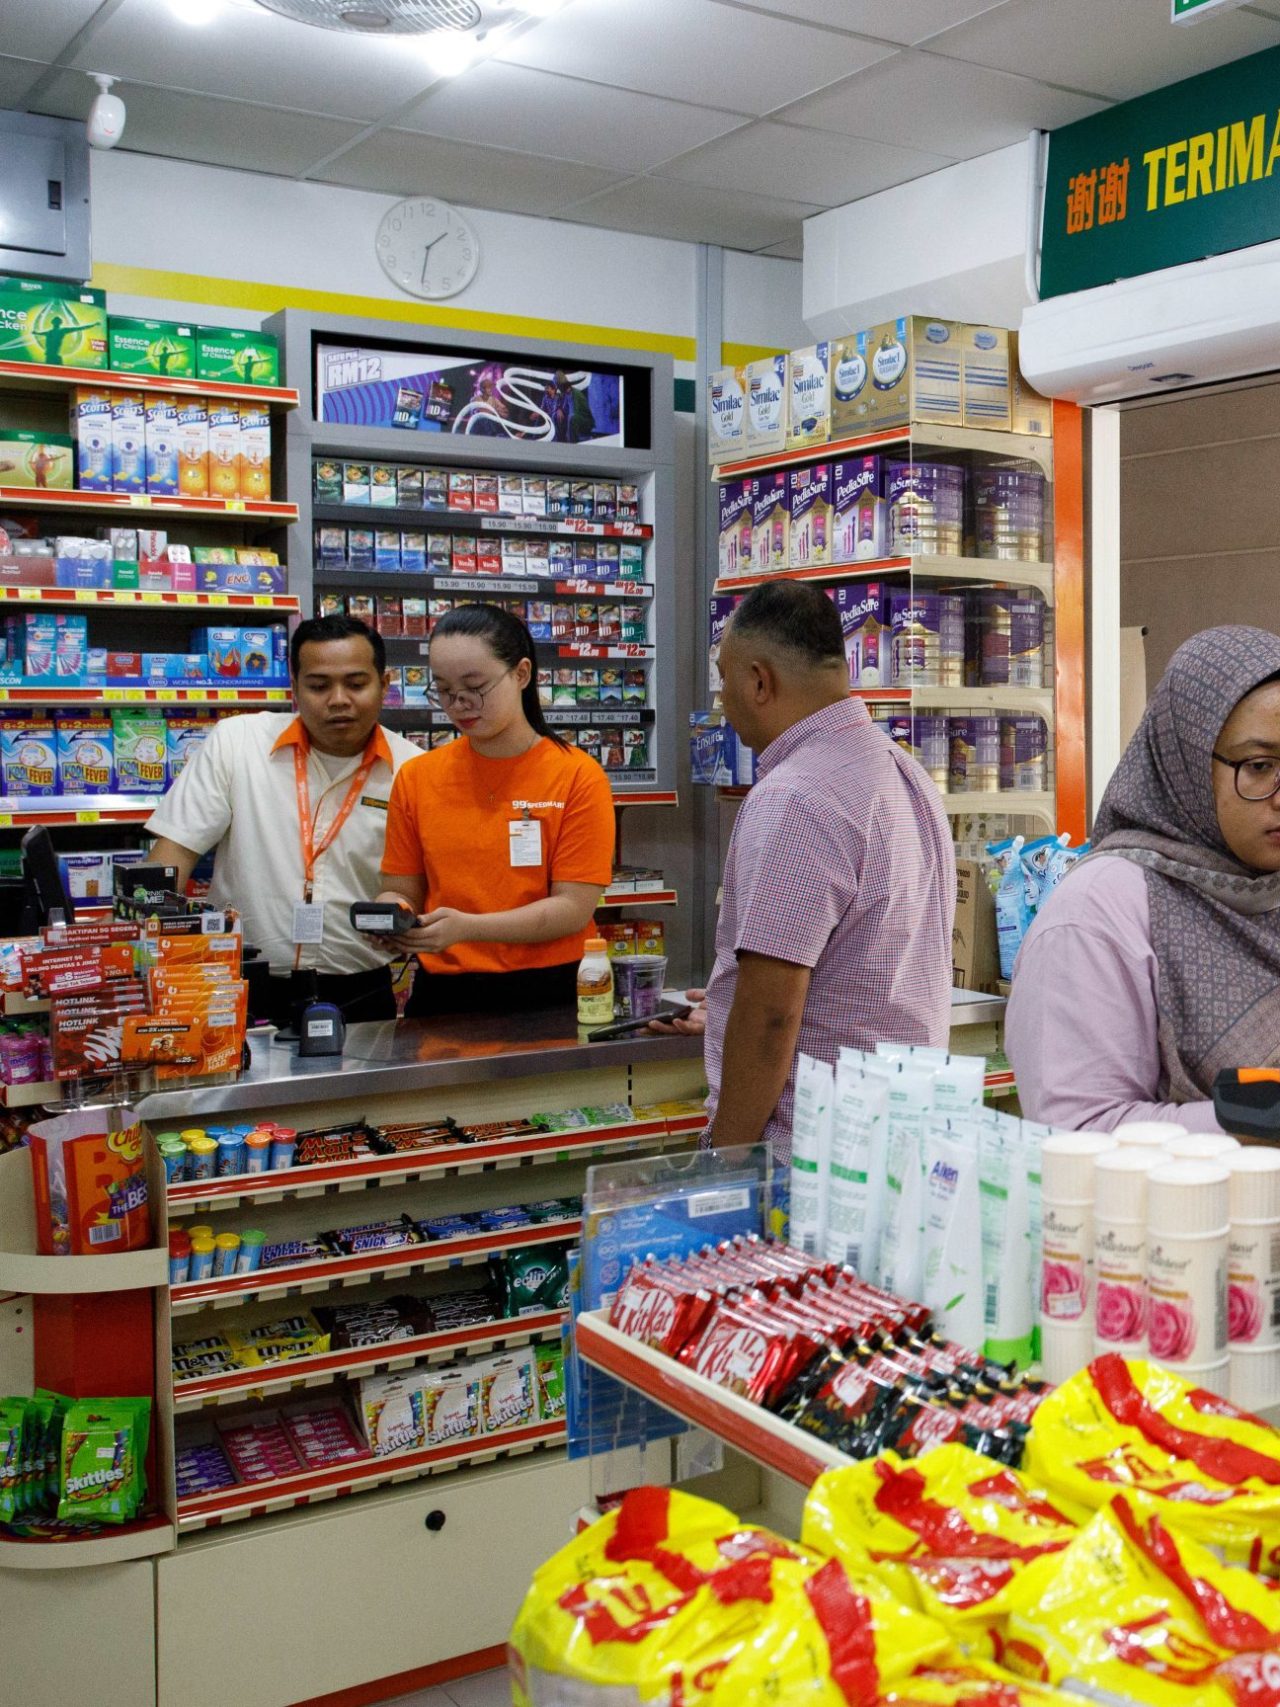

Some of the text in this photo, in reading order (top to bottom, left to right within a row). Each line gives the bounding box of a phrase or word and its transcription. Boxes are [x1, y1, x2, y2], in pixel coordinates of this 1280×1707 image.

[420, 202, 435, 217] 12
[114, 336, 150, 346] Essence
[202, 344, 236, 355] Essence
[878, 354, 896, 367] Similac
[328, 357, 380, 388] RM12
[793, 374, 824, 394] Similac
[712, 396, 742, 414] Similac
[750, 388, 780, 406] Similac
[801, 392, 814, 403] Gold
[721, 411, 734, 422] Gold
[758, 405, 771, 415] Gold
[754, 488, 785, 514] PediaSure
[792, 482, 827, 509] PediaSure
[226, 574, 249, 585] ENO
[29, 769, 53, 785] FEVER
[86, 768, 110, 784] FEVER
[141, 764, 163, 780] FEVER
[56, 997, 95, 1006] HOTLINK
[57, 1007, 97, 1015] HOTLINK
[59, 1018, 99, 1026] HOTLINK
[930, 1160, 959, 1183] Aiken
[486, 1396, 532, 1429] Skittles
[429, 1415, 477, 1445] Skittles
[375, 1425, 424, 1457] Skittles
[66, 1468, 124, 1492] Skittles
